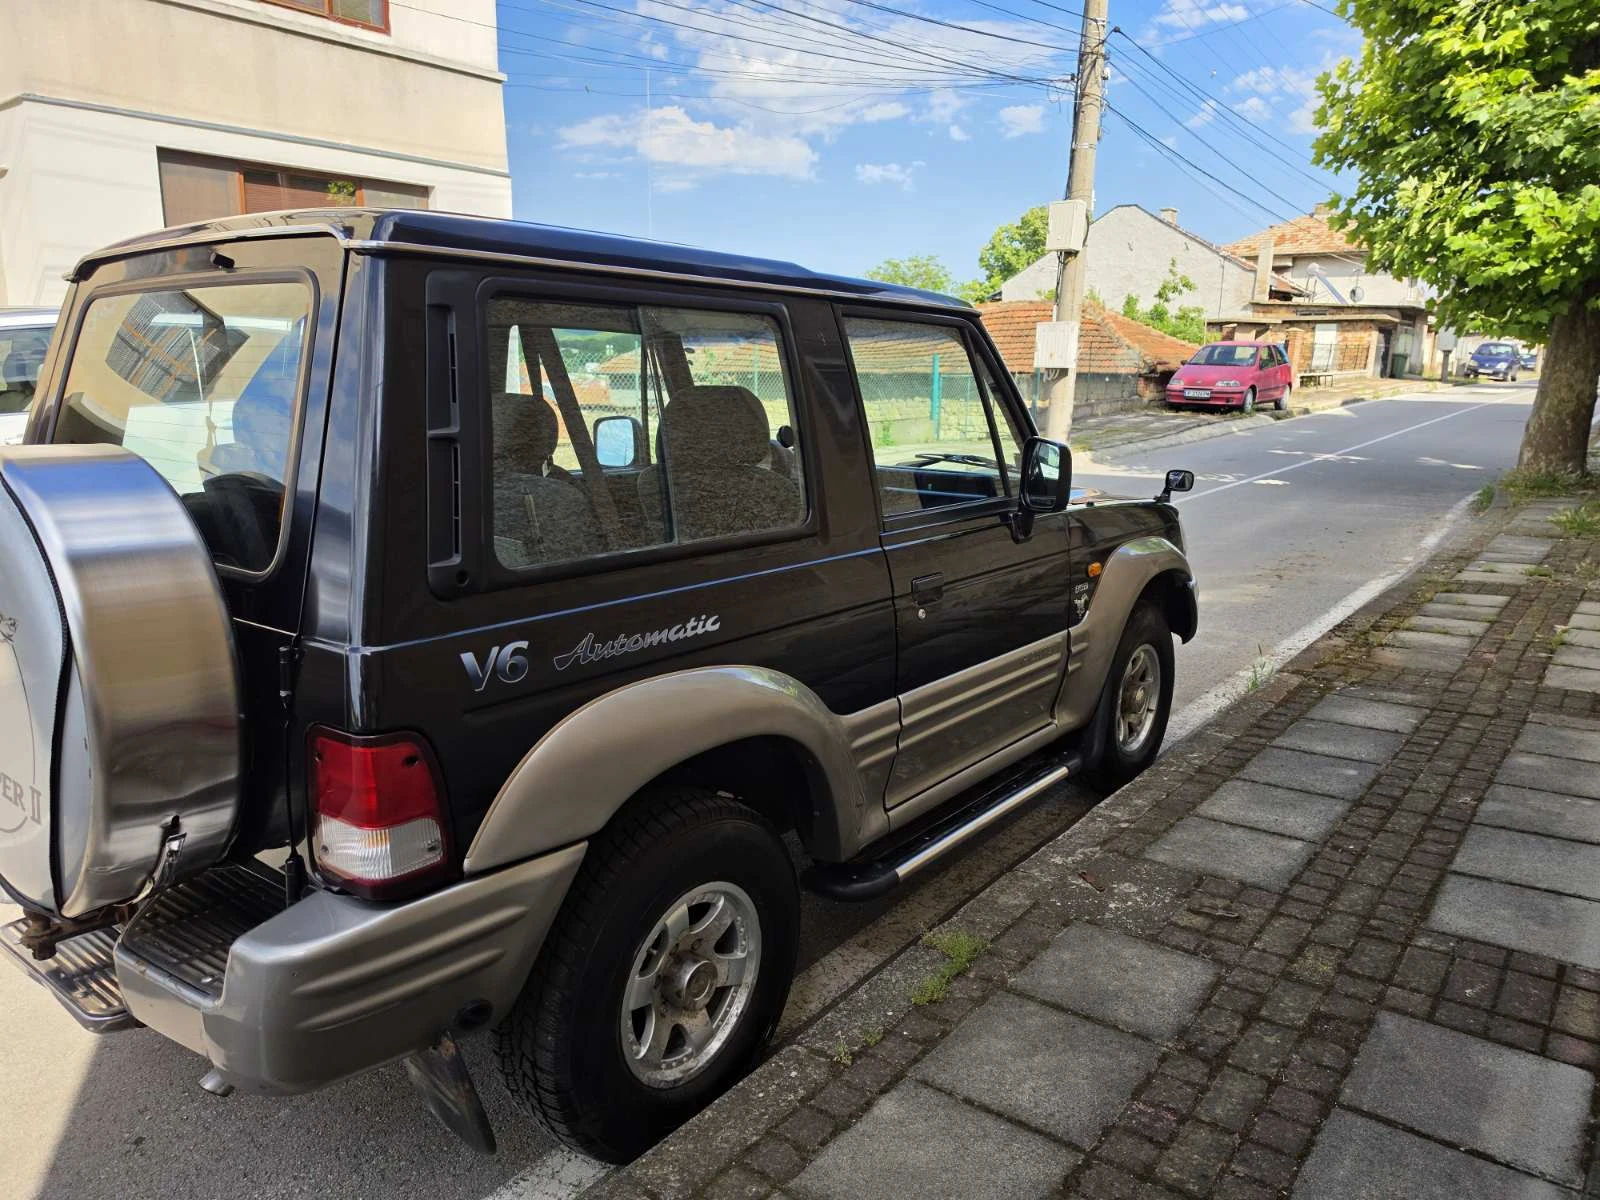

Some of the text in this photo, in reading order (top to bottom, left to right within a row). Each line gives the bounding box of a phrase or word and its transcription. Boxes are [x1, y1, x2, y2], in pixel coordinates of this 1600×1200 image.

[460, 640, 529, 692] V6
[553, 614, 721, 671] Automatic
[0, 771, 26, 812] ER
